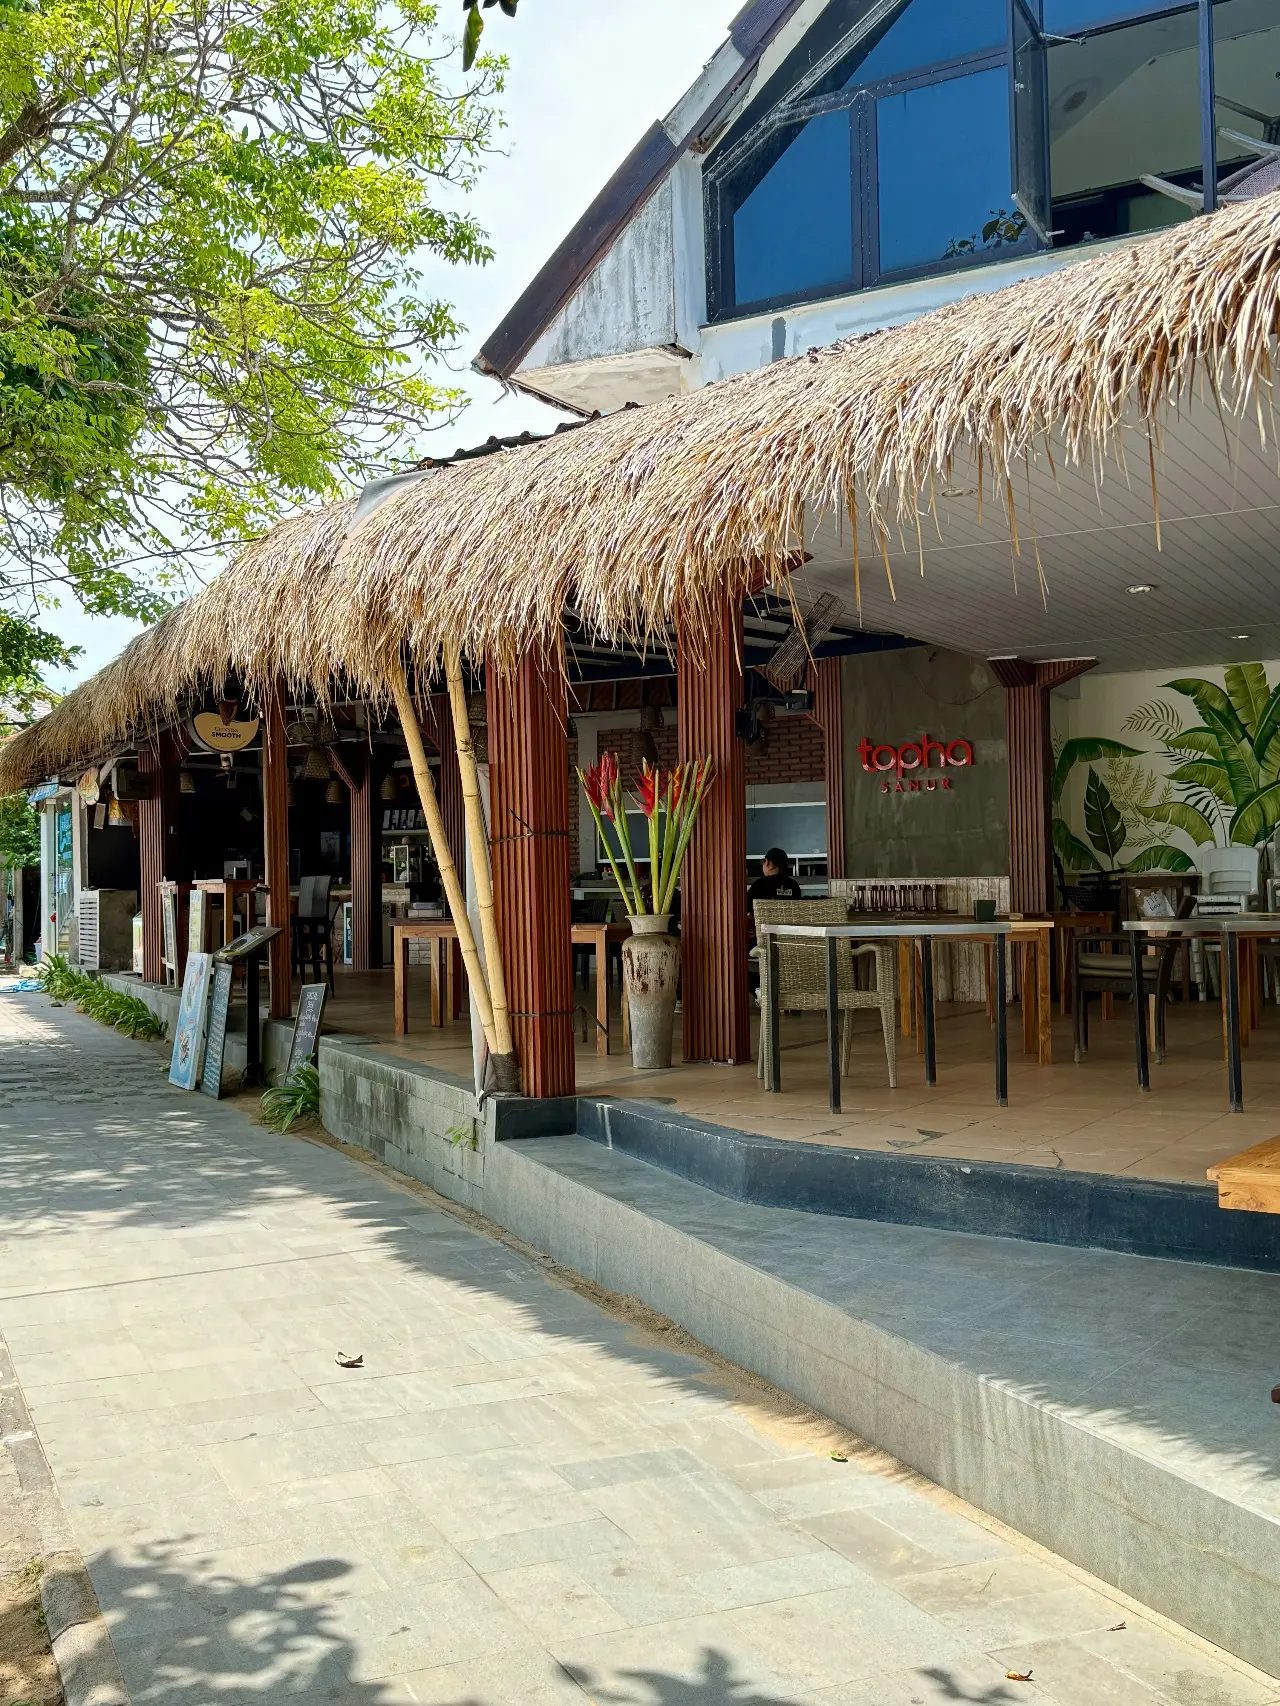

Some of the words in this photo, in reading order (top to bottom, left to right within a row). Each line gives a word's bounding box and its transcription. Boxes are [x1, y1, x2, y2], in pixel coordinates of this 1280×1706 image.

[211, 731, 241, 739] SMOOTH
[856, 733, 972, 779] tapha
[880, 778, 951, 793] SANUR
